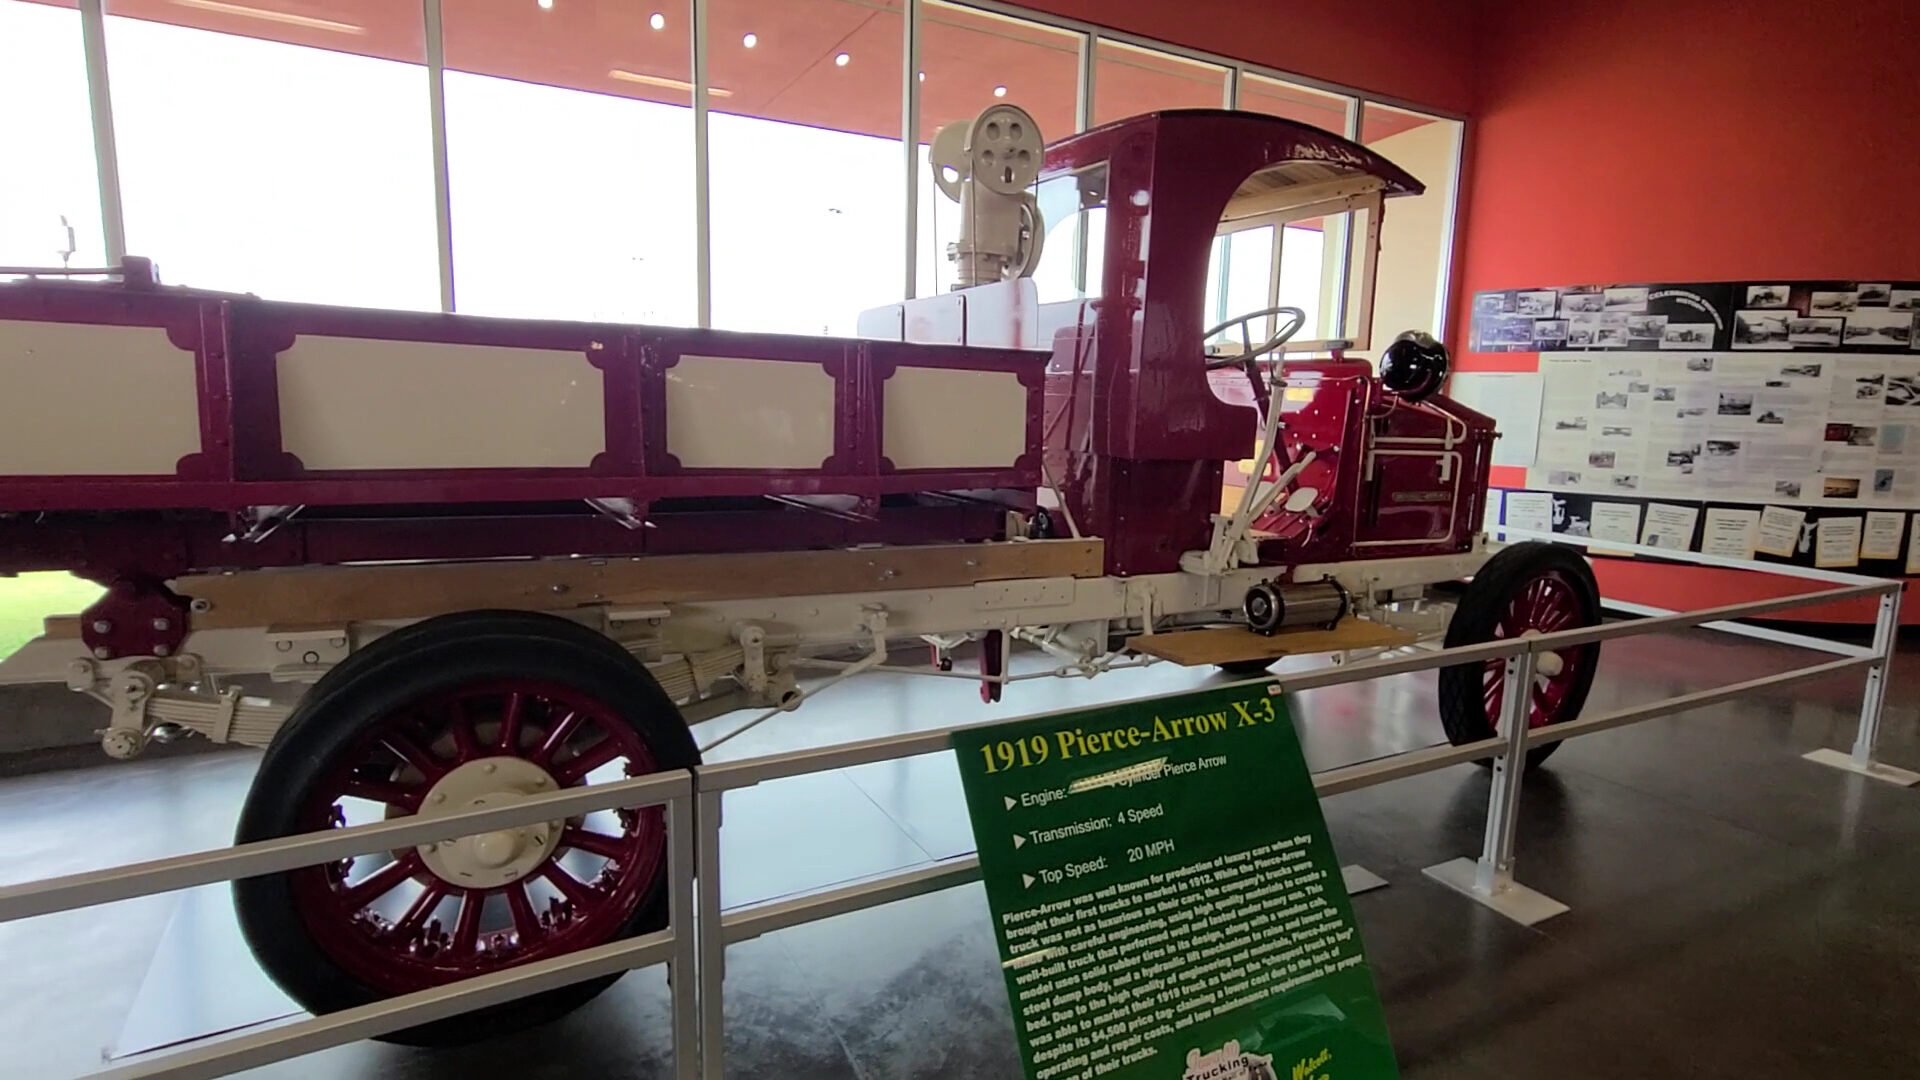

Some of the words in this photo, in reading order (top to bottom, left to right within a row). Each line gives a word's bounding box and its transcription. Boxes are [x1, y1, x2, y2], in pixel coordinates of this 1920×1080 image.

[980, 735, 1049, 773] 1919
[1054, 711, 1227, 759] Pierce-Arrow
[1232, 698, 1275, 727] X-3
[1021, 788, 1068, 806] Engine:
[1164, 762, 1197, 777] Pierce
[1198, 755, 1227, 770] Arrow
[1029, 817, 1112, 844] Transmission:
[1117, 812, 1126, 824] 4
[1127, 803, 1164, 823] Speed
[1038, 869, 1063, 884] Top
[1065, 856, 1108, 878] Speed:
[1127, 848, 1143, 862] 20
[1145, 839, 1175, 858] MPH
[1002, 899, 1071, 924] Pierce-Arrow
[1072, 893, 1094, 905] was
[1094, 884, 1116, 899] well
[1116, 878, 1149, 893] known
[1005, 919, 1048, 939] brought
[1048, 912, 1074, 927] their
[1075, 905, 1098, 920] first
[1098, 897, 1131, 913] trucks
[1131, 894, 1142, 904] to
[1008, 937, 1039, 954] truck
[1039, 932, 1063, 945] was
[1063, 925, 1082, 938] not
[1083, 922, 1096, 933] as
[1096, 909, 1143, 929] luxurious
[1069, 932, 1106, 952] careful
[1015, 961, 1066, 984] well-built
[1066, 952, 1095, 969] truck
[1096, 945, 1118, 960] that
[1019, 980, 1053, 1000] model
[1054, 974, 1080, 989] uses
[1081, 963, 1107, 980] solid
[1107, 954, 1141, 972] rubber
[1022, 997, 1051, 1015] steel
[1052, 990, 1082, 1006] dump
[1082, 980, 1112, 996] body,
[1112, 971, 1132, 986] and
[1132, 971, 1140, 980] a
[1025, 1015, 1051, 1031] bed.
[1051, 1009, 1073, 1023] Due
[1074, 1004, 1087, 1015] to
[1088, 998, 1106, 1010] the
[1107, 988, 1130, 1004] high
[1028, 1032, 1053, 1047] was
[1054, 1023, 1078, 1039] able
[1079, 1019, 1092, 1030] to
[1092, 1004, 1130, 1025] market
[1032, 1042, 1073, 1063] despite
[1074, 1036, 1090, 1048] its
[1090, 1021, 1126, 1043] $4,500
[1036, 1053, 1088, 1080] operating
[1089, 1043, 1110, 1060] and
[1111, 1033, 1141, 1052] repair
[1081, 1066, 1092, 1080] of
[1094, 1058, 1120, 1075] their
